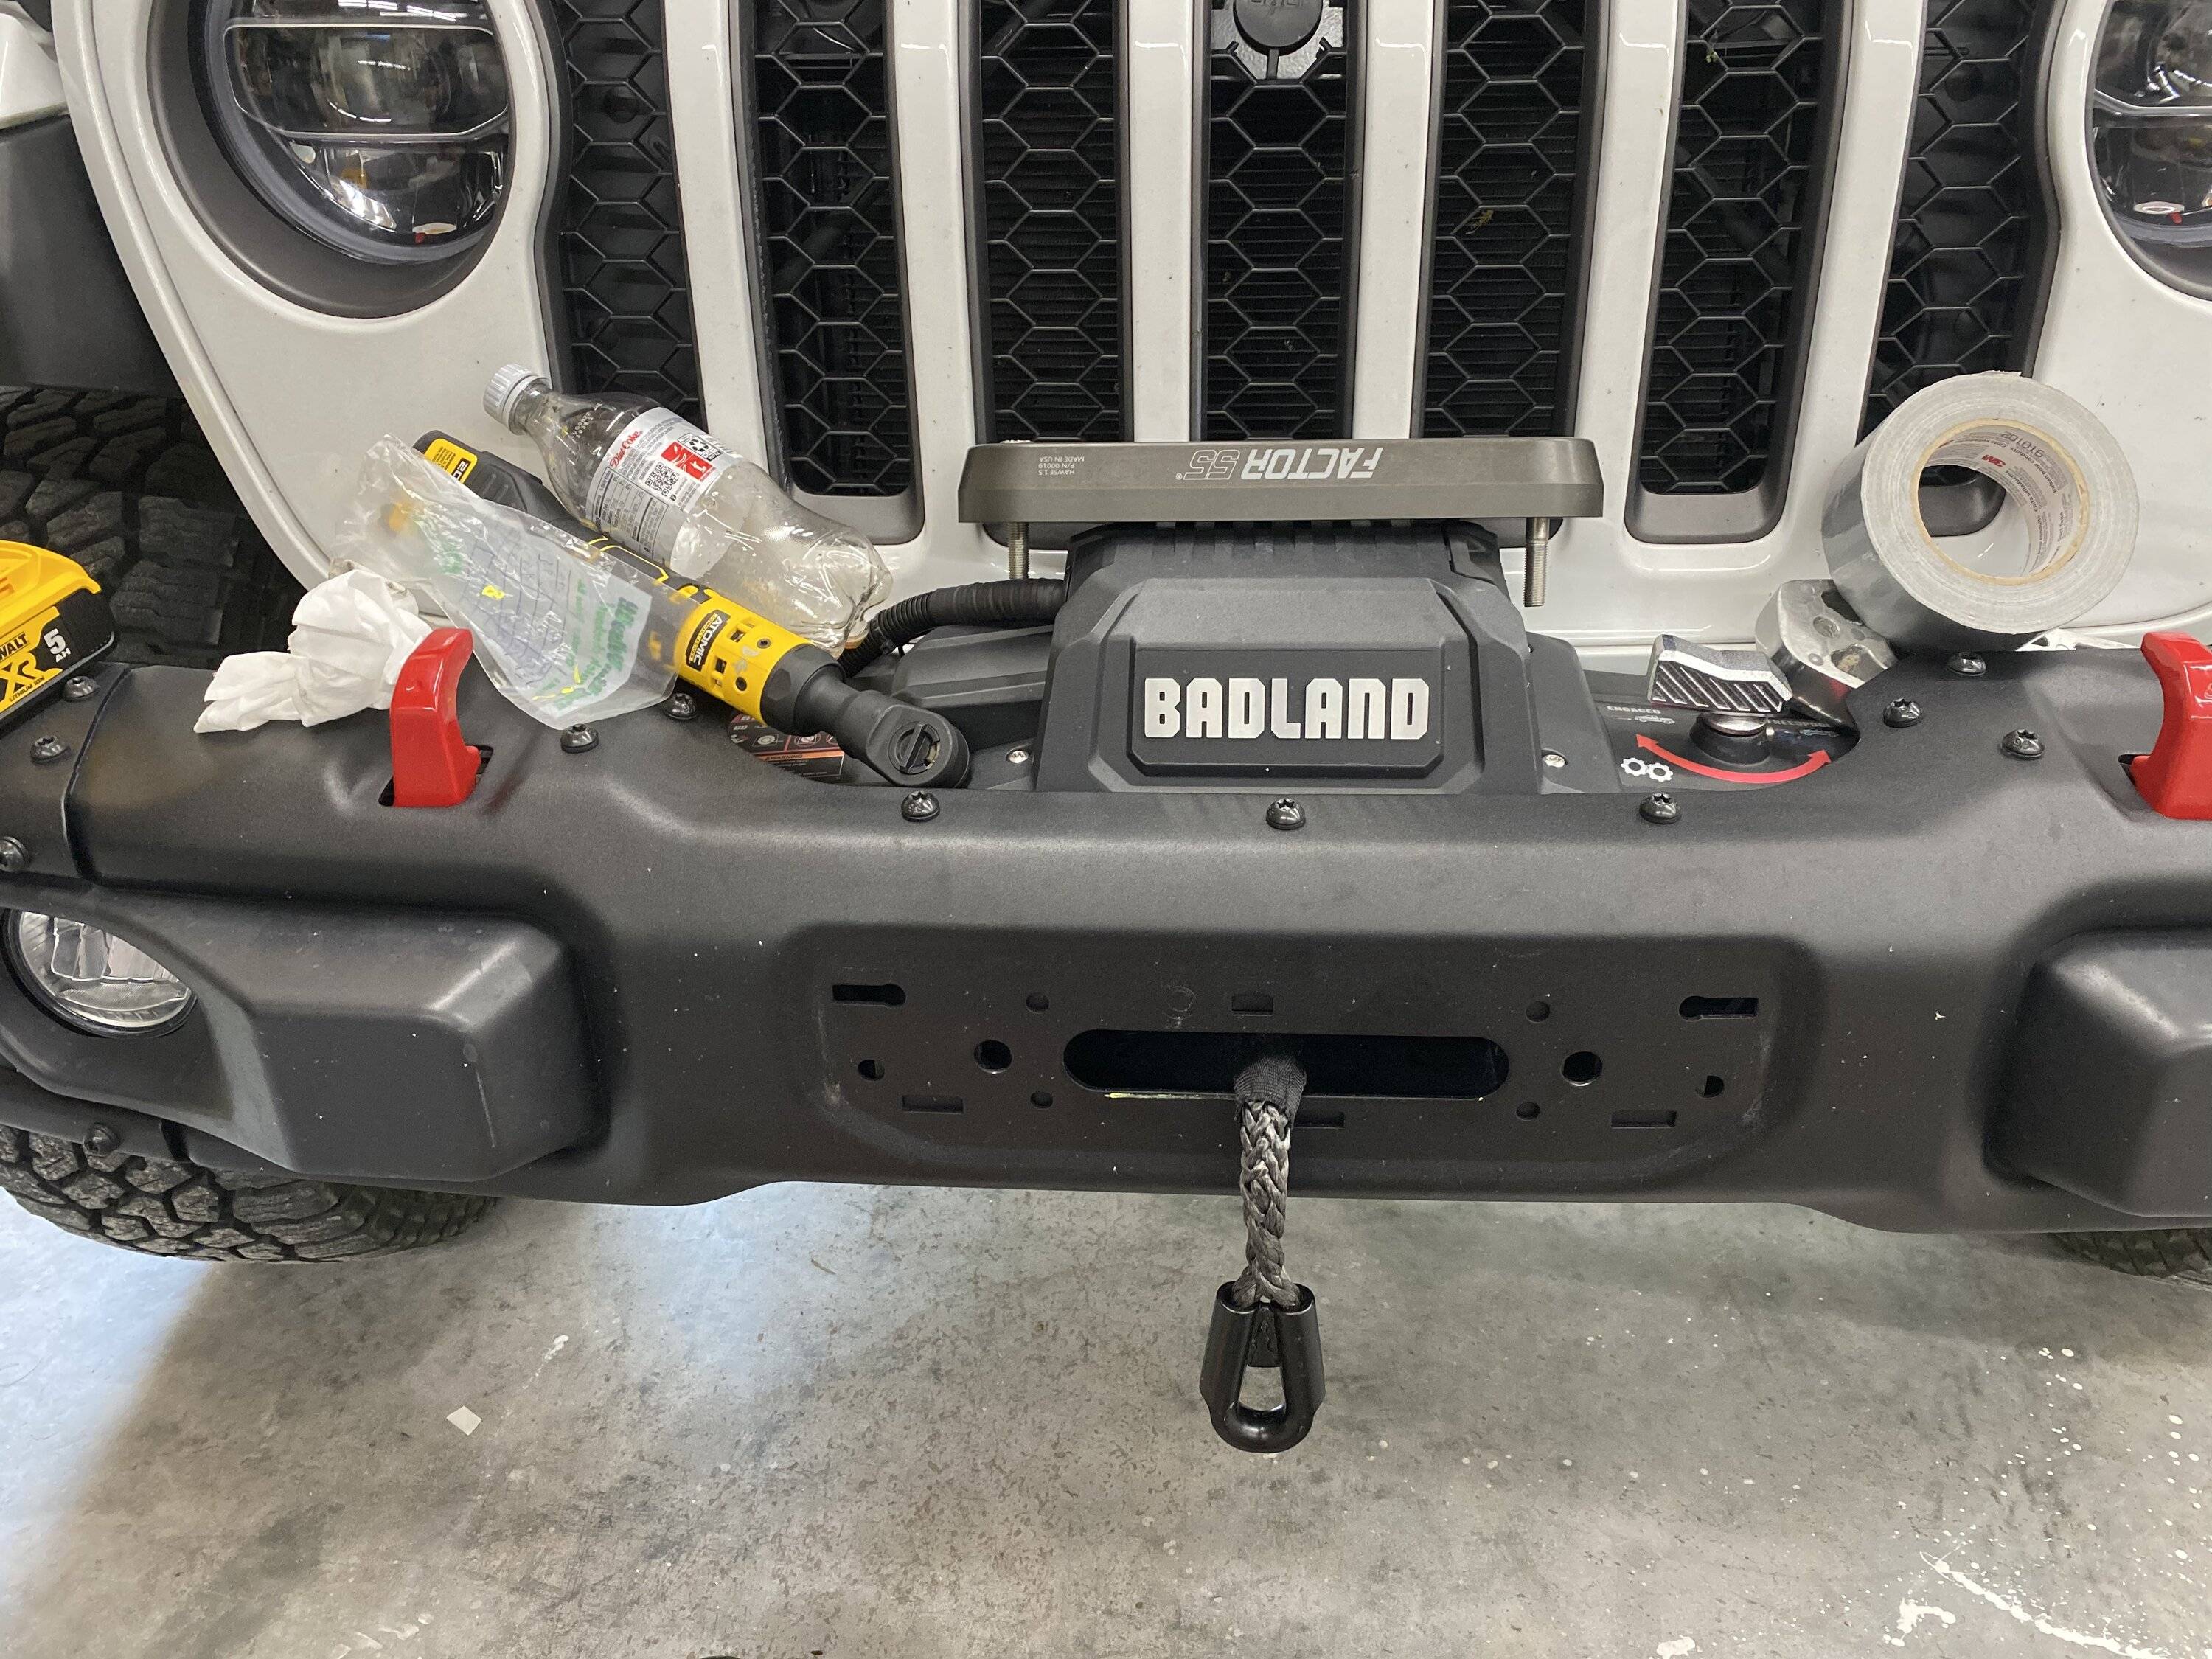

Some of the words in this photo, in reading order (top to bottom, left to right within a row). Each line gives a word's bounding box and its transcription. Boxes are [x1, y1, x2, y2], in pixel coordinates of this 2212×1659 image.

[609, 448, 625, 468] Diet
[622, 431, 641, 450] Coke
[1240, 447, 1384, 479] FACTOR
[1982, 454, 2006, 467] 3M
[44, 628, 66, 655] 5
[693, 615, 723, 666] ATOMIC
[9, 684, 33, 702] LITHIUM
[1144, 678, 1430, 740] BADLAND
